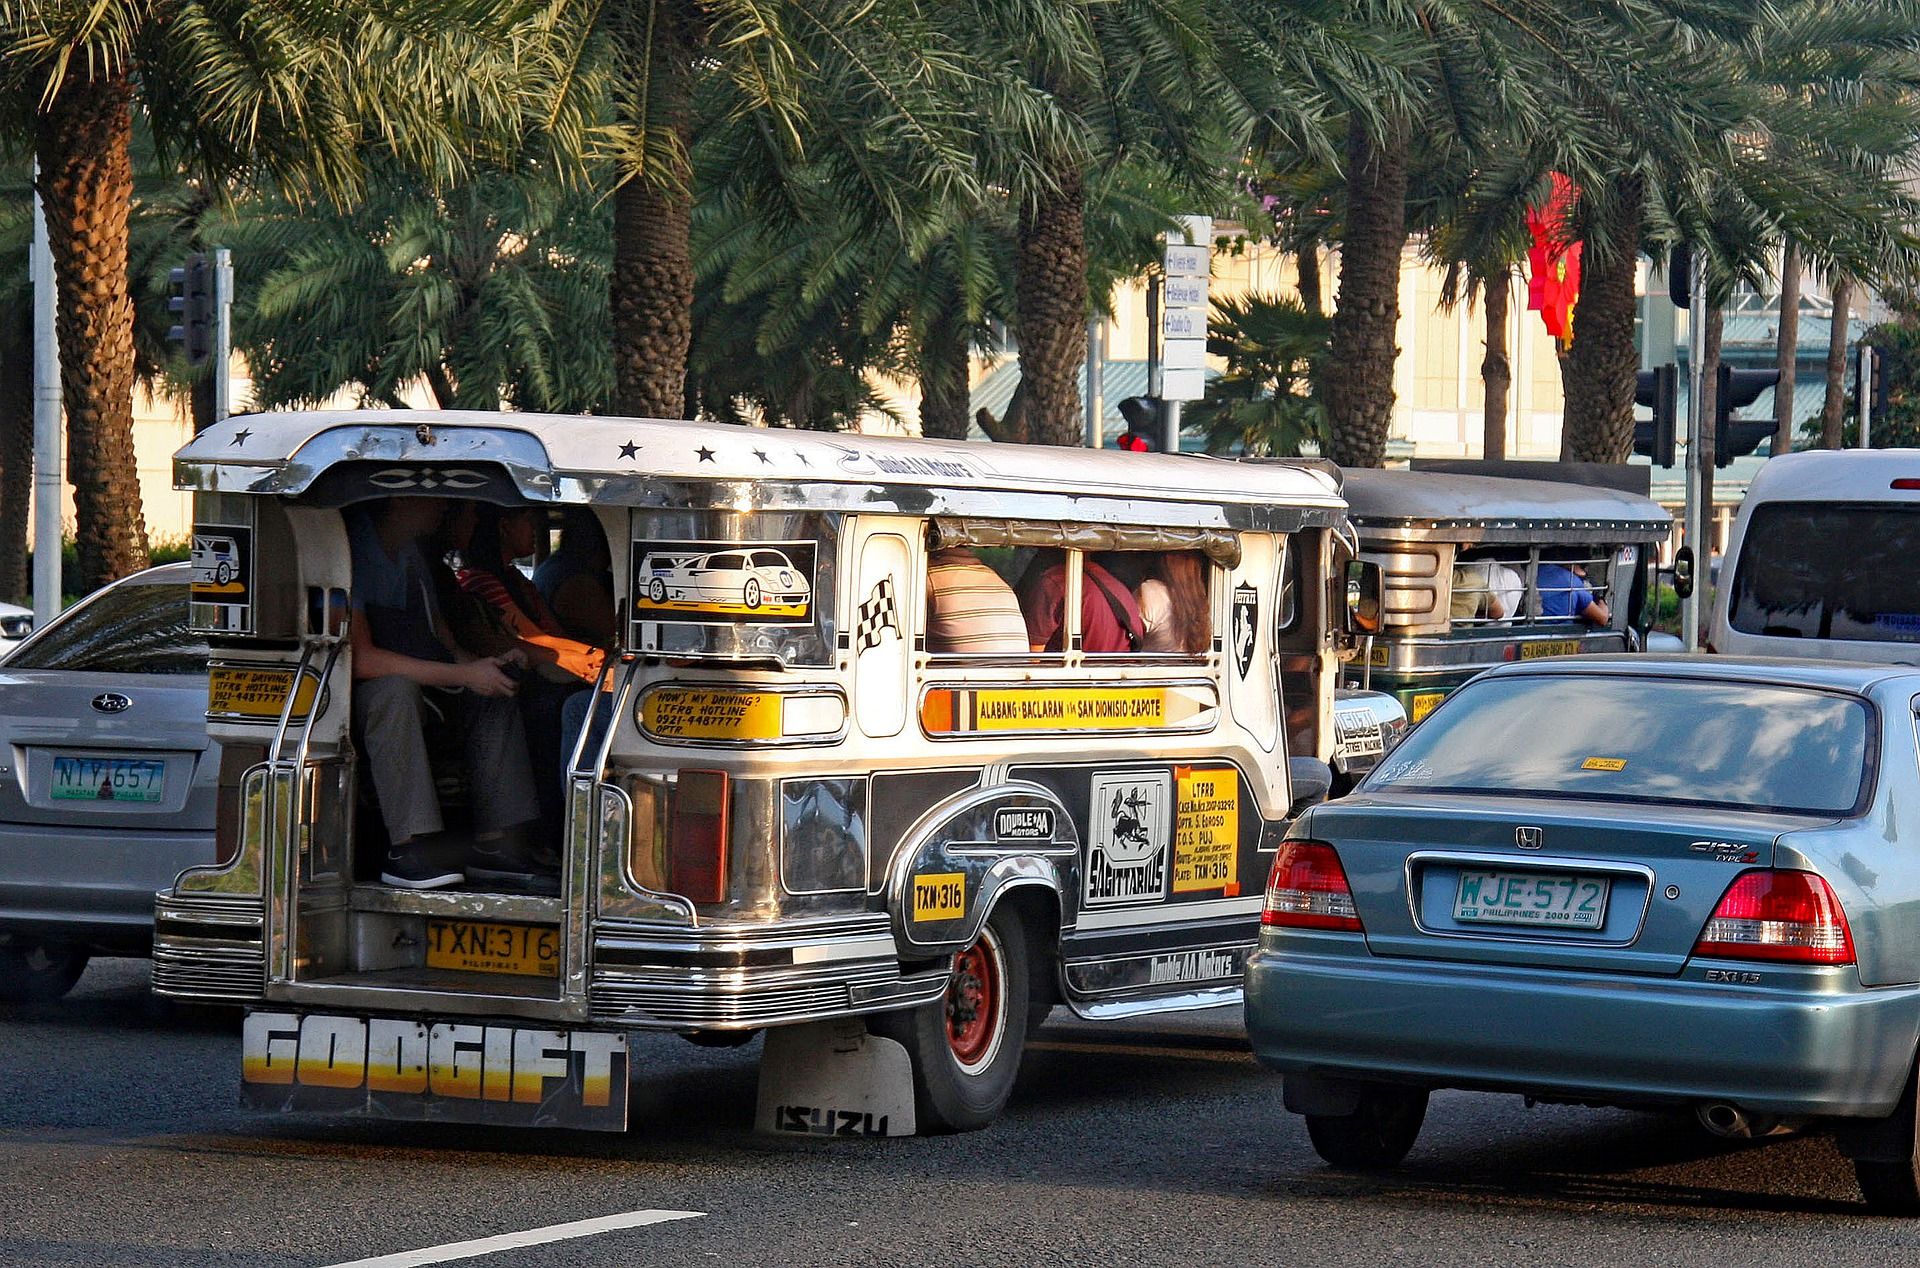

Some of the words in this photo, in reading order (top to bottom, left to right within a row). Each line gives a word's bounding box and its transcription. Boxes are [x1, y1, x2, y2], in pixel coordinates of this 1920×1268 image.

[246, 683, 288, 694] HOTLINE
[657, 692, 688, 704] HOW'S
[692, 694, 708, 702] MY
[711, 695, 761, 707] DRIVING?
[656, 704, 693, 714] LTFRB
[700, 706, 747, 716] HOTLINE
[1078, 700, 1094, 718] SAN
[656, 716, 742, 727] 0921-4487777
[656, 725, 684, 735] OPTR.
[1346, 742, 1363, 753] STREET
[113, 763, 156, 789] 657
[1192, 782, 1215, 798] LTFRB
[1000, 812, 1033, 835] DOUBLE
[1012, 828, 1039, 836] MOTORS
[1199, 830, 1213, 845] PUJ
[1715, 854, 1742, 863] TYPE
[1089, 844, 1164, 898] SAGITTARIUS
[1482, 908, 1541, 919] PHILIPPINES
[1545, 911, 1570, 920] 2000
[1150, 955, 1182, 982] Double
[1181, 953, 1196, 980] AA
[1198, 951, 1232, 979] Motors
[775, 1105, 888, 1137] ISUZU
